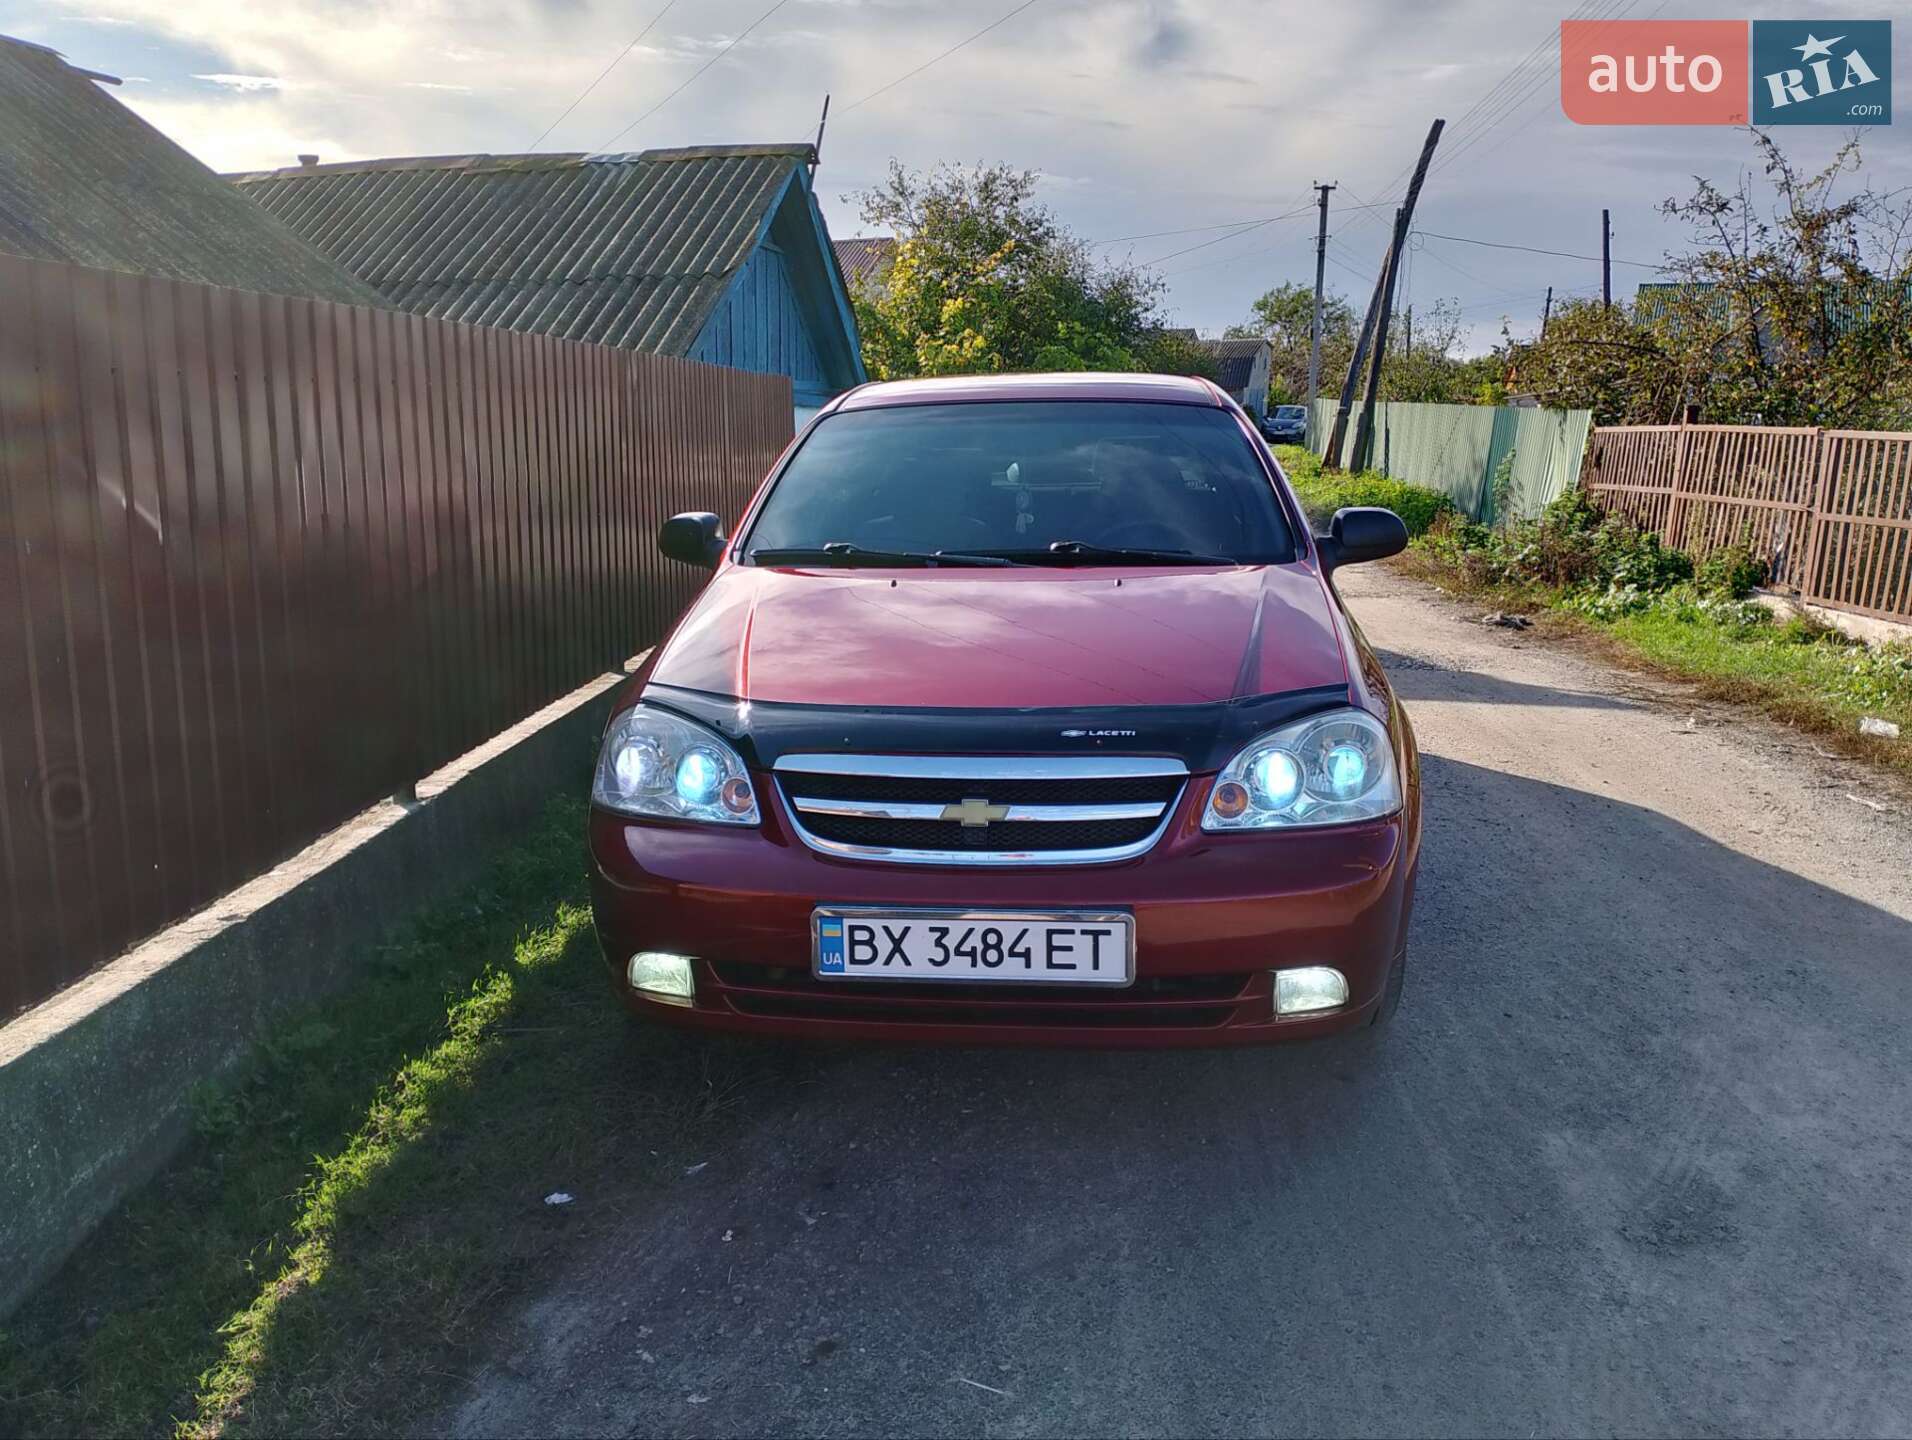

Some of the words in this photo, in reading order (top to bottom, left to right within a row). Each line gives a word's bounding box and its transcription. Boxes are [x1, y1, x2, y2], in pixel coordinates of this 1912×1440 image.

[822, 952, 843, 966] UA
[847, 924, 912, 967] BX
[927, 926, 1032, 969] 3484
[1045, 928, 1112, 971] ET
